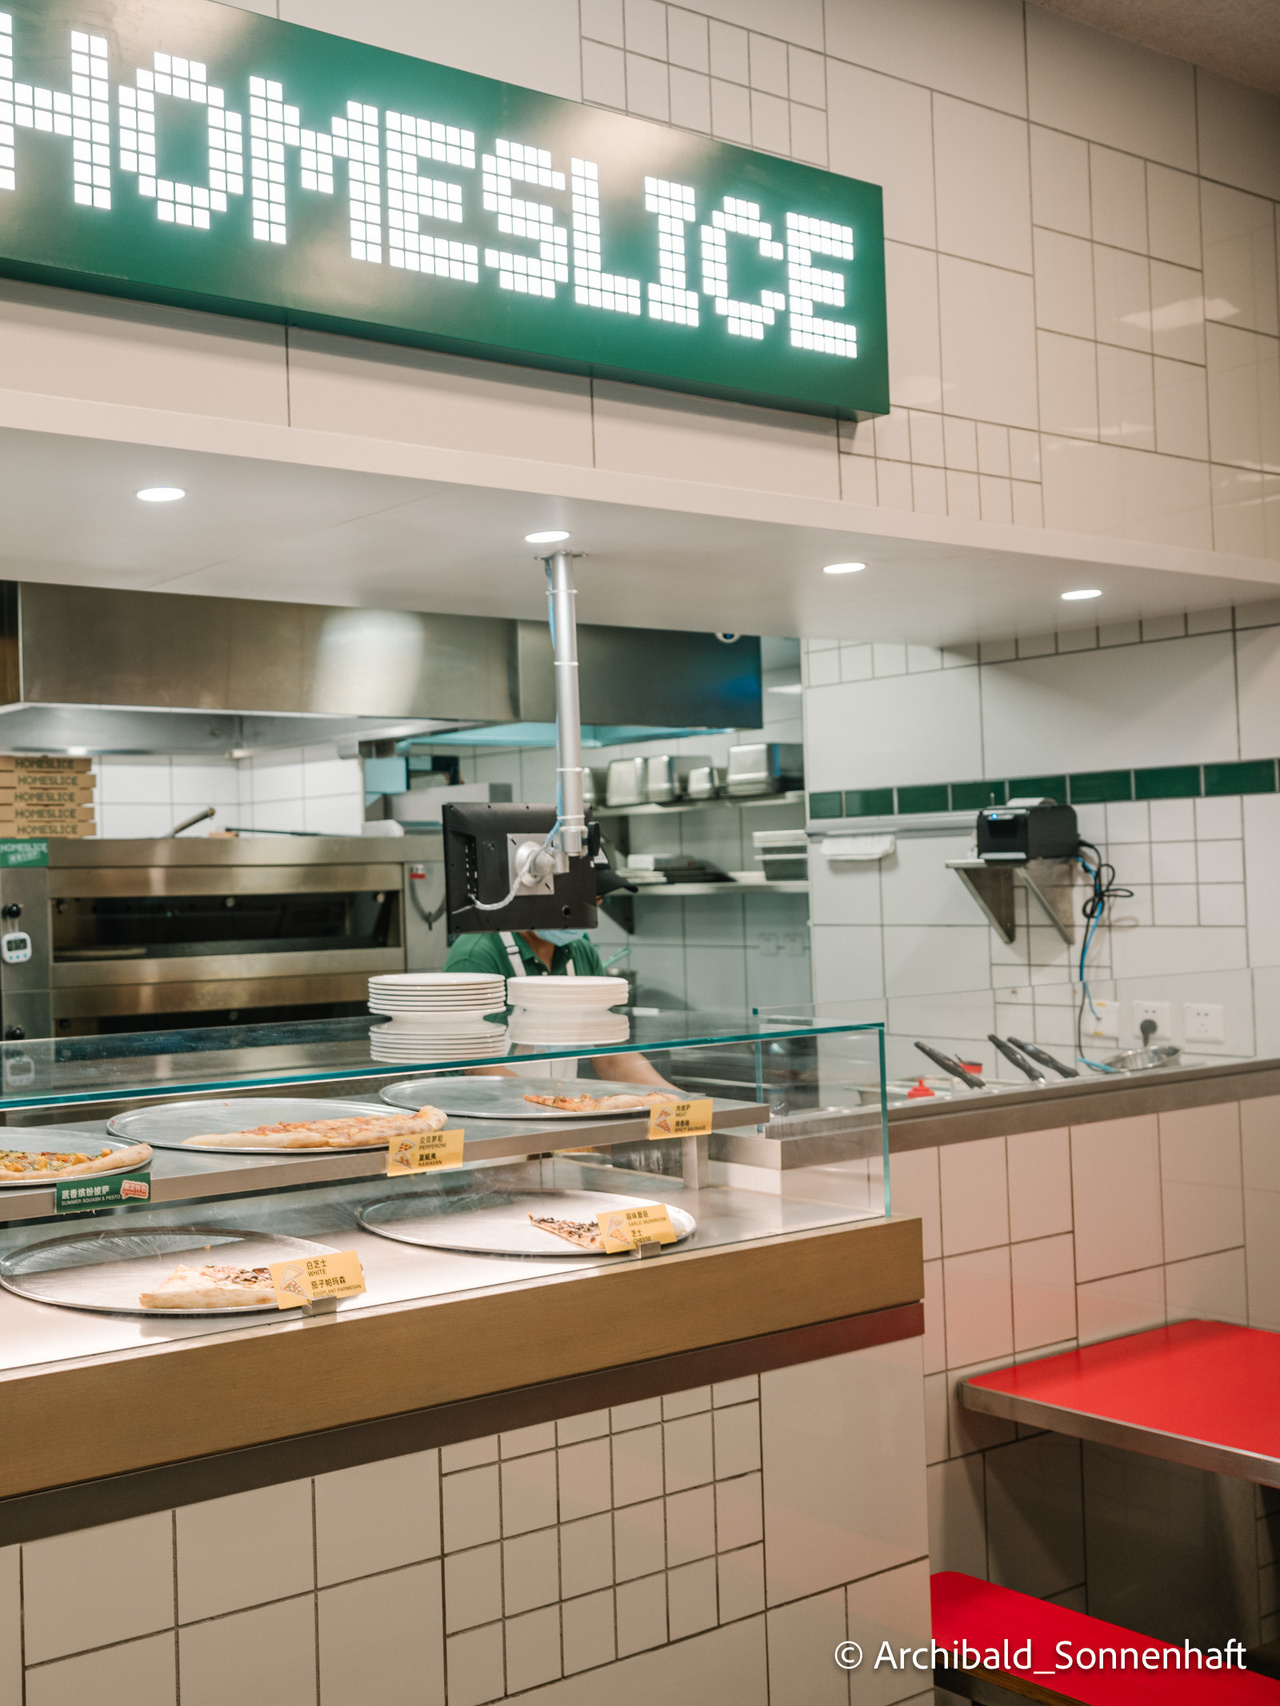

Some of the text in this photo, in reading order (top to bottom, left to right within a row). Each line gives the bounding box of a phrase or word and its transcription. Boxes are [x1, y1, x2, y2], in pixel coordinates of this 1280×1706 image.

[15, 758, 74, 770] HOMESLICE
[18, 775, 78, 786] HOMESLICE
[14, 792, 76, 802] HOMESLICE
[16, 808, 76, 819] HOMESLICE
[17, 824, 78, 835] HOMESLICE
[306, 1259, 327, 1270] 白芝士
[308, 1268, 326, 1278] WHITE
[313, 1284, 362, 1298] EGGPLANT PARMESAN
